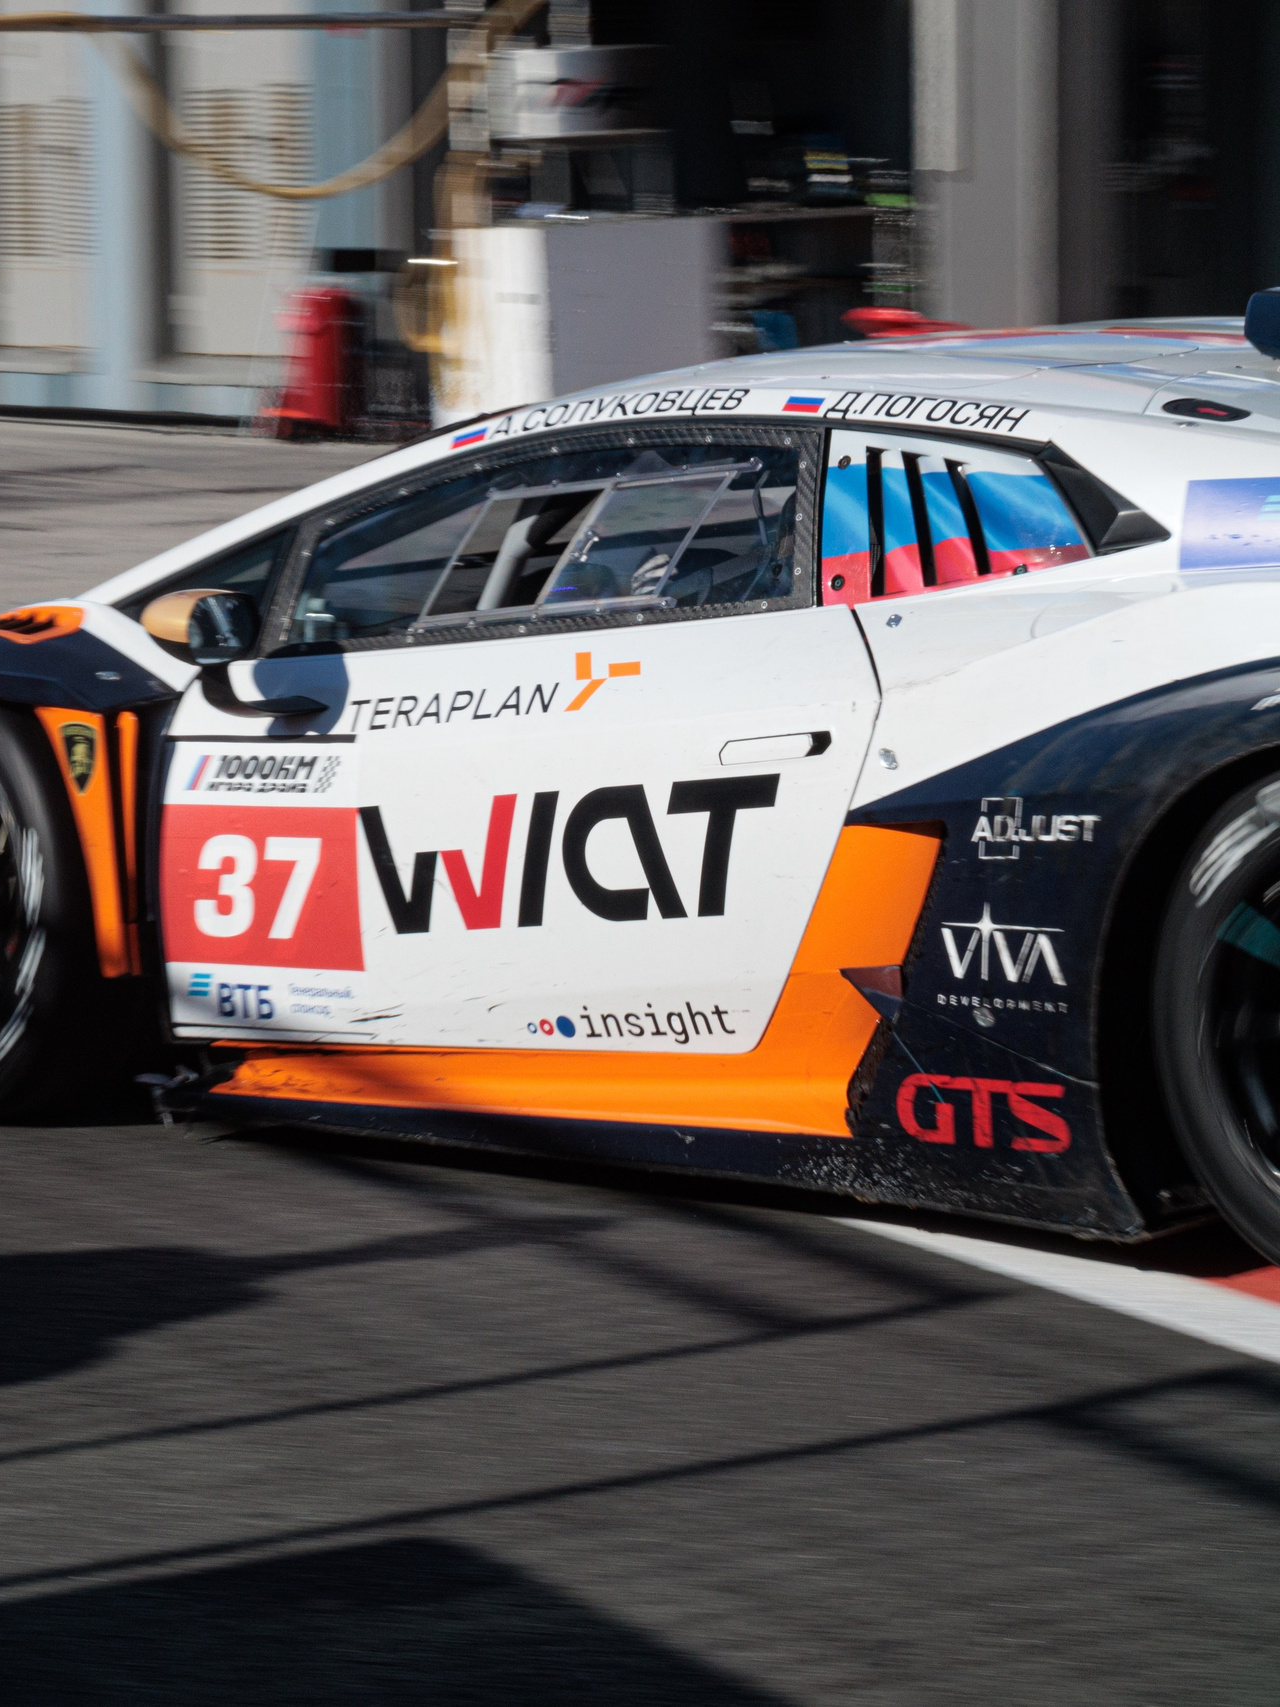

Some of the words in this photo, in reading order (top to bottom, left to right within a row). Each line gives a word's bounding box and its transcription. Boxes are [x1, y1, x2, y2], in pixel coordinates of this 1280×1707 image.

[490, 387, 750, 437] А.СОЛУКОВЦЕВ
[824, 391, 1030, 432] Д.ПОГОСЯН
[350, 682, 561, 733] TERAPLAN
[193, 834, 323, 940] 37
[940, 902, 1068, 987] VIVA
[217, 983, 276, 1020] ВТБ
[581, 1002, 737, 1045] insight
[895, 1073, 1072, 1154] GTS
